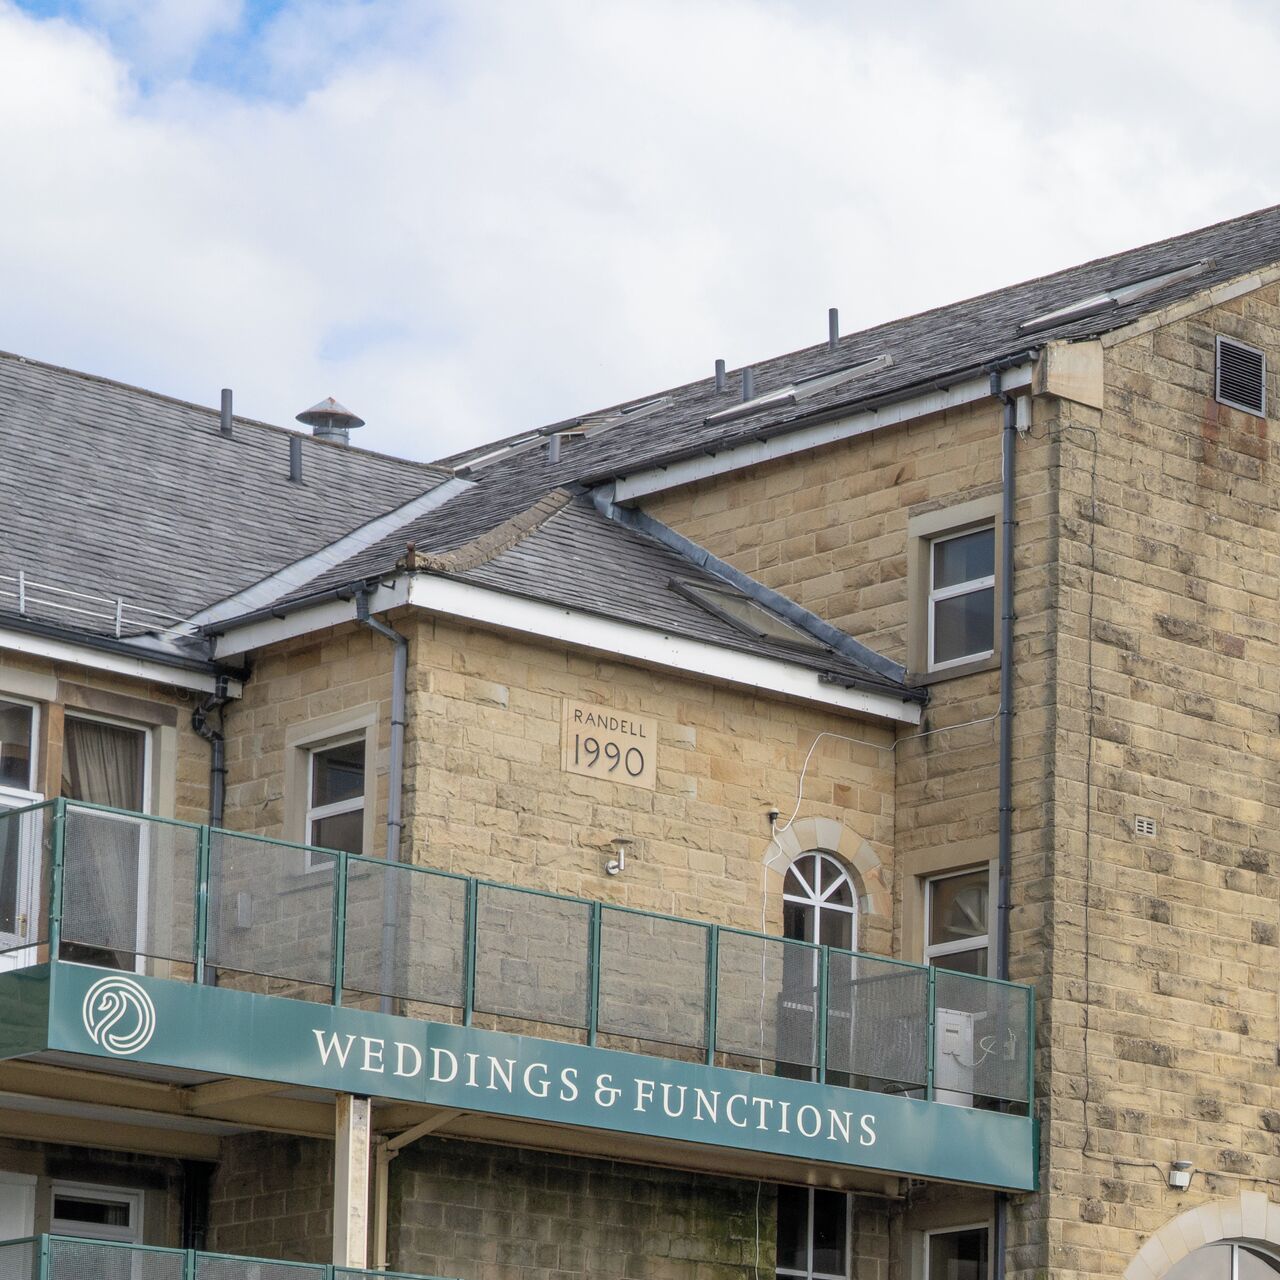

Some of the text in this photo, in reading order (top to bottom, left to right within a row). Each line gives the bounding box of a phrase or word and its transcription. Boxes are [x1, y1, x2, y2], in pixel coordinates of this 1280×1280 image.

[574, 709, 646, 738] RANDELL
[575, 735, 644, 777] 1990
[312, 1029, 878, 1147] WEDDINGS & FUNCTIONS
